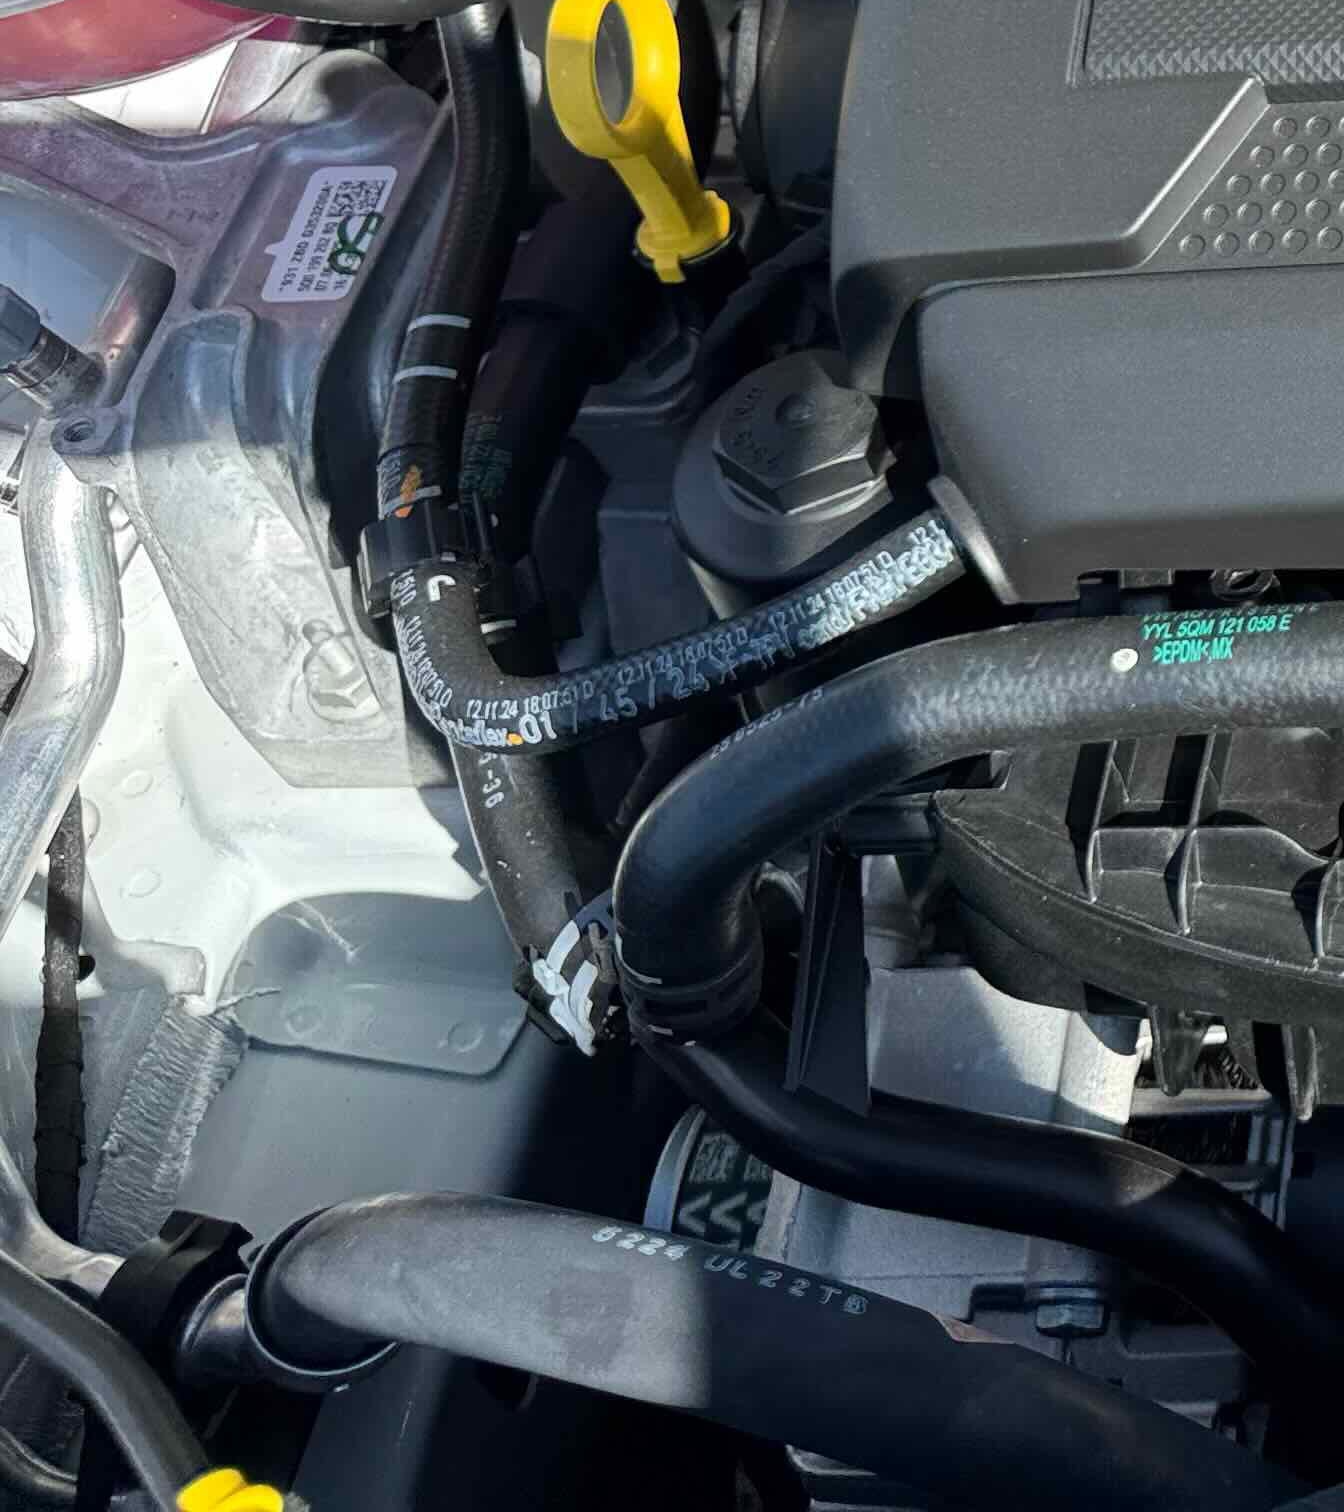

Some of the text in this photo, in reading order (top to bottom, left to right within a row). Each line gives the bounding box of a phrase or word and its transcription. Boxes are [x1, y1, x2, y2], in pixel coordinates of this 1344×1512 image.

[1143, 614, 1294, 640] YYL 5QM 121 058 E
